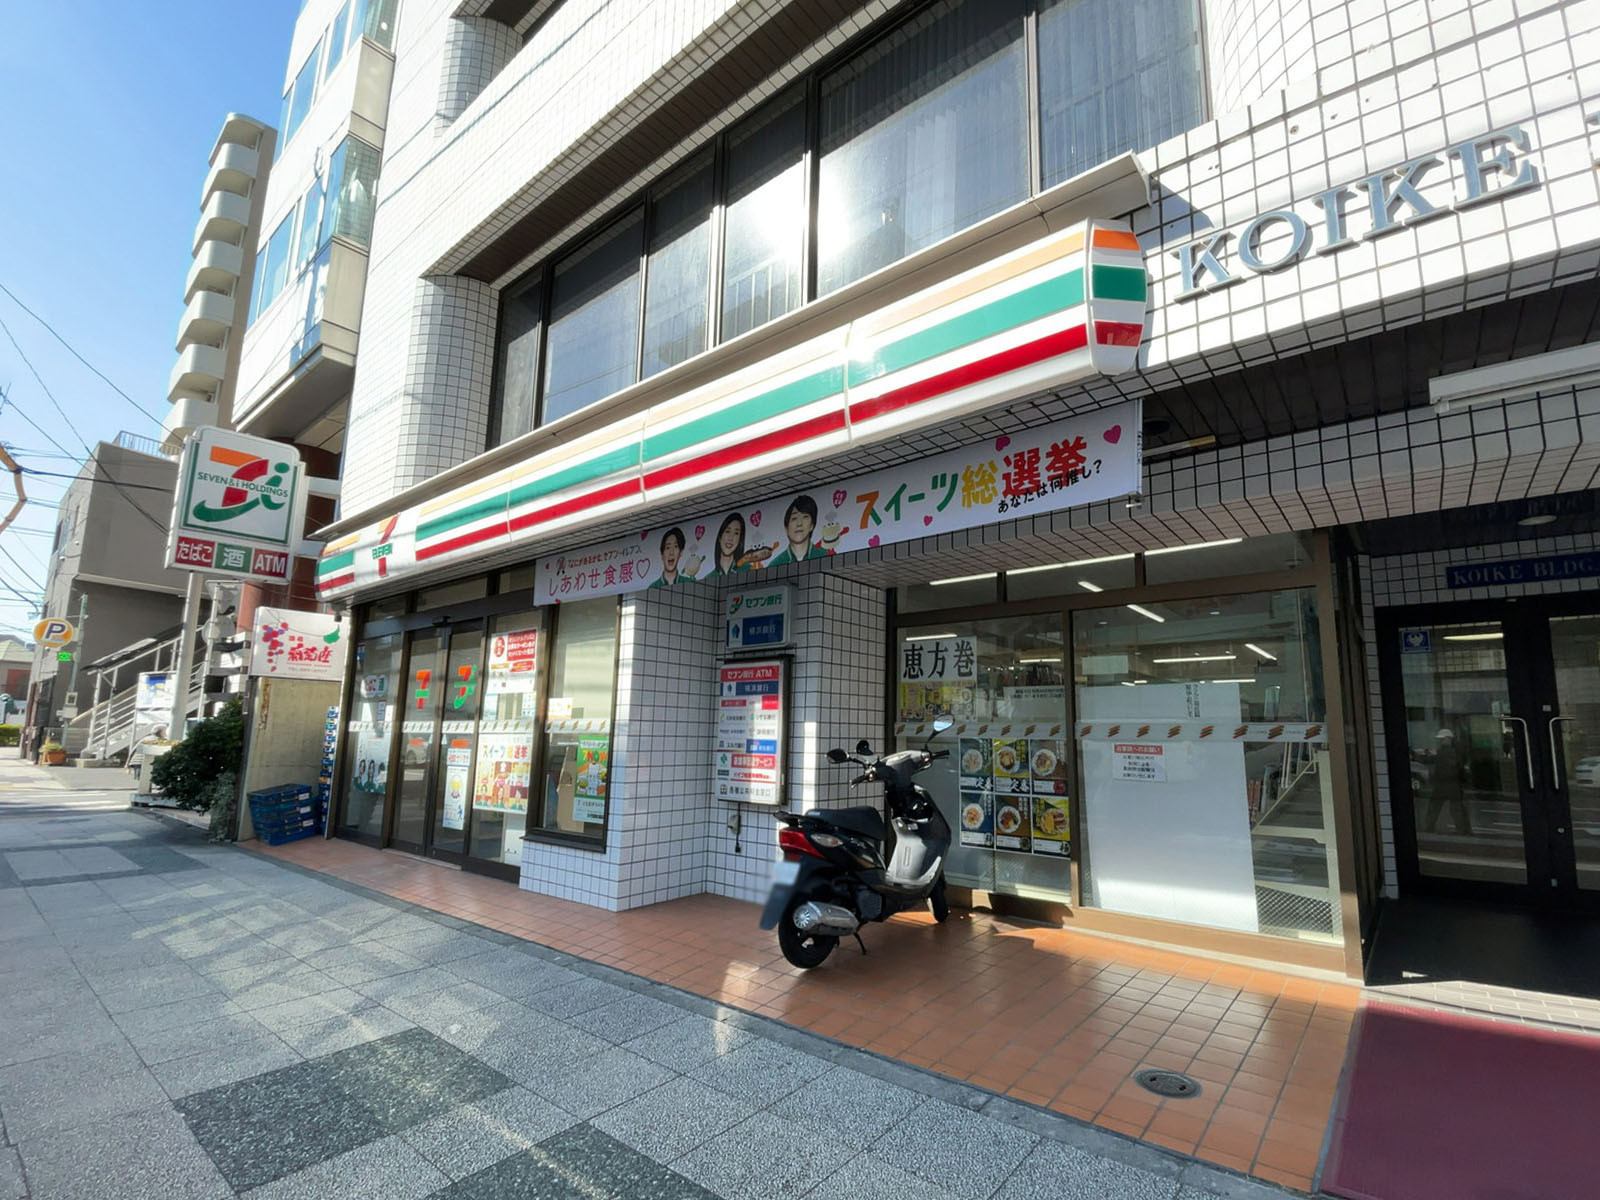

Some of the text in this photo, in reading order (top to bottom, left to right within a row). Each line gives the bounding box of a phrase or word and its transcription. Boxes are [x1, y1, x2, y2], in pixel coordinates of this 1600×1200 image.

[1171, 124, 1541, 303] KOIKE
[241, 481, 288, 498] HOLDINGS
[855, 436, 1088, 530] スイーツ総選挙
[177, 541, 213, 563] たばこ
[222, 547, 246, 568] 酒
[254, 554, 285, 574] ATM
[1453, 564, 1523, 585] KOIKE
[746, 594, 783, 609] セブン銀行
[45, 622, 66, 640] P
[903, 640, 975, 679] 恵方巻
[755, 669, 773, 678] ATM
